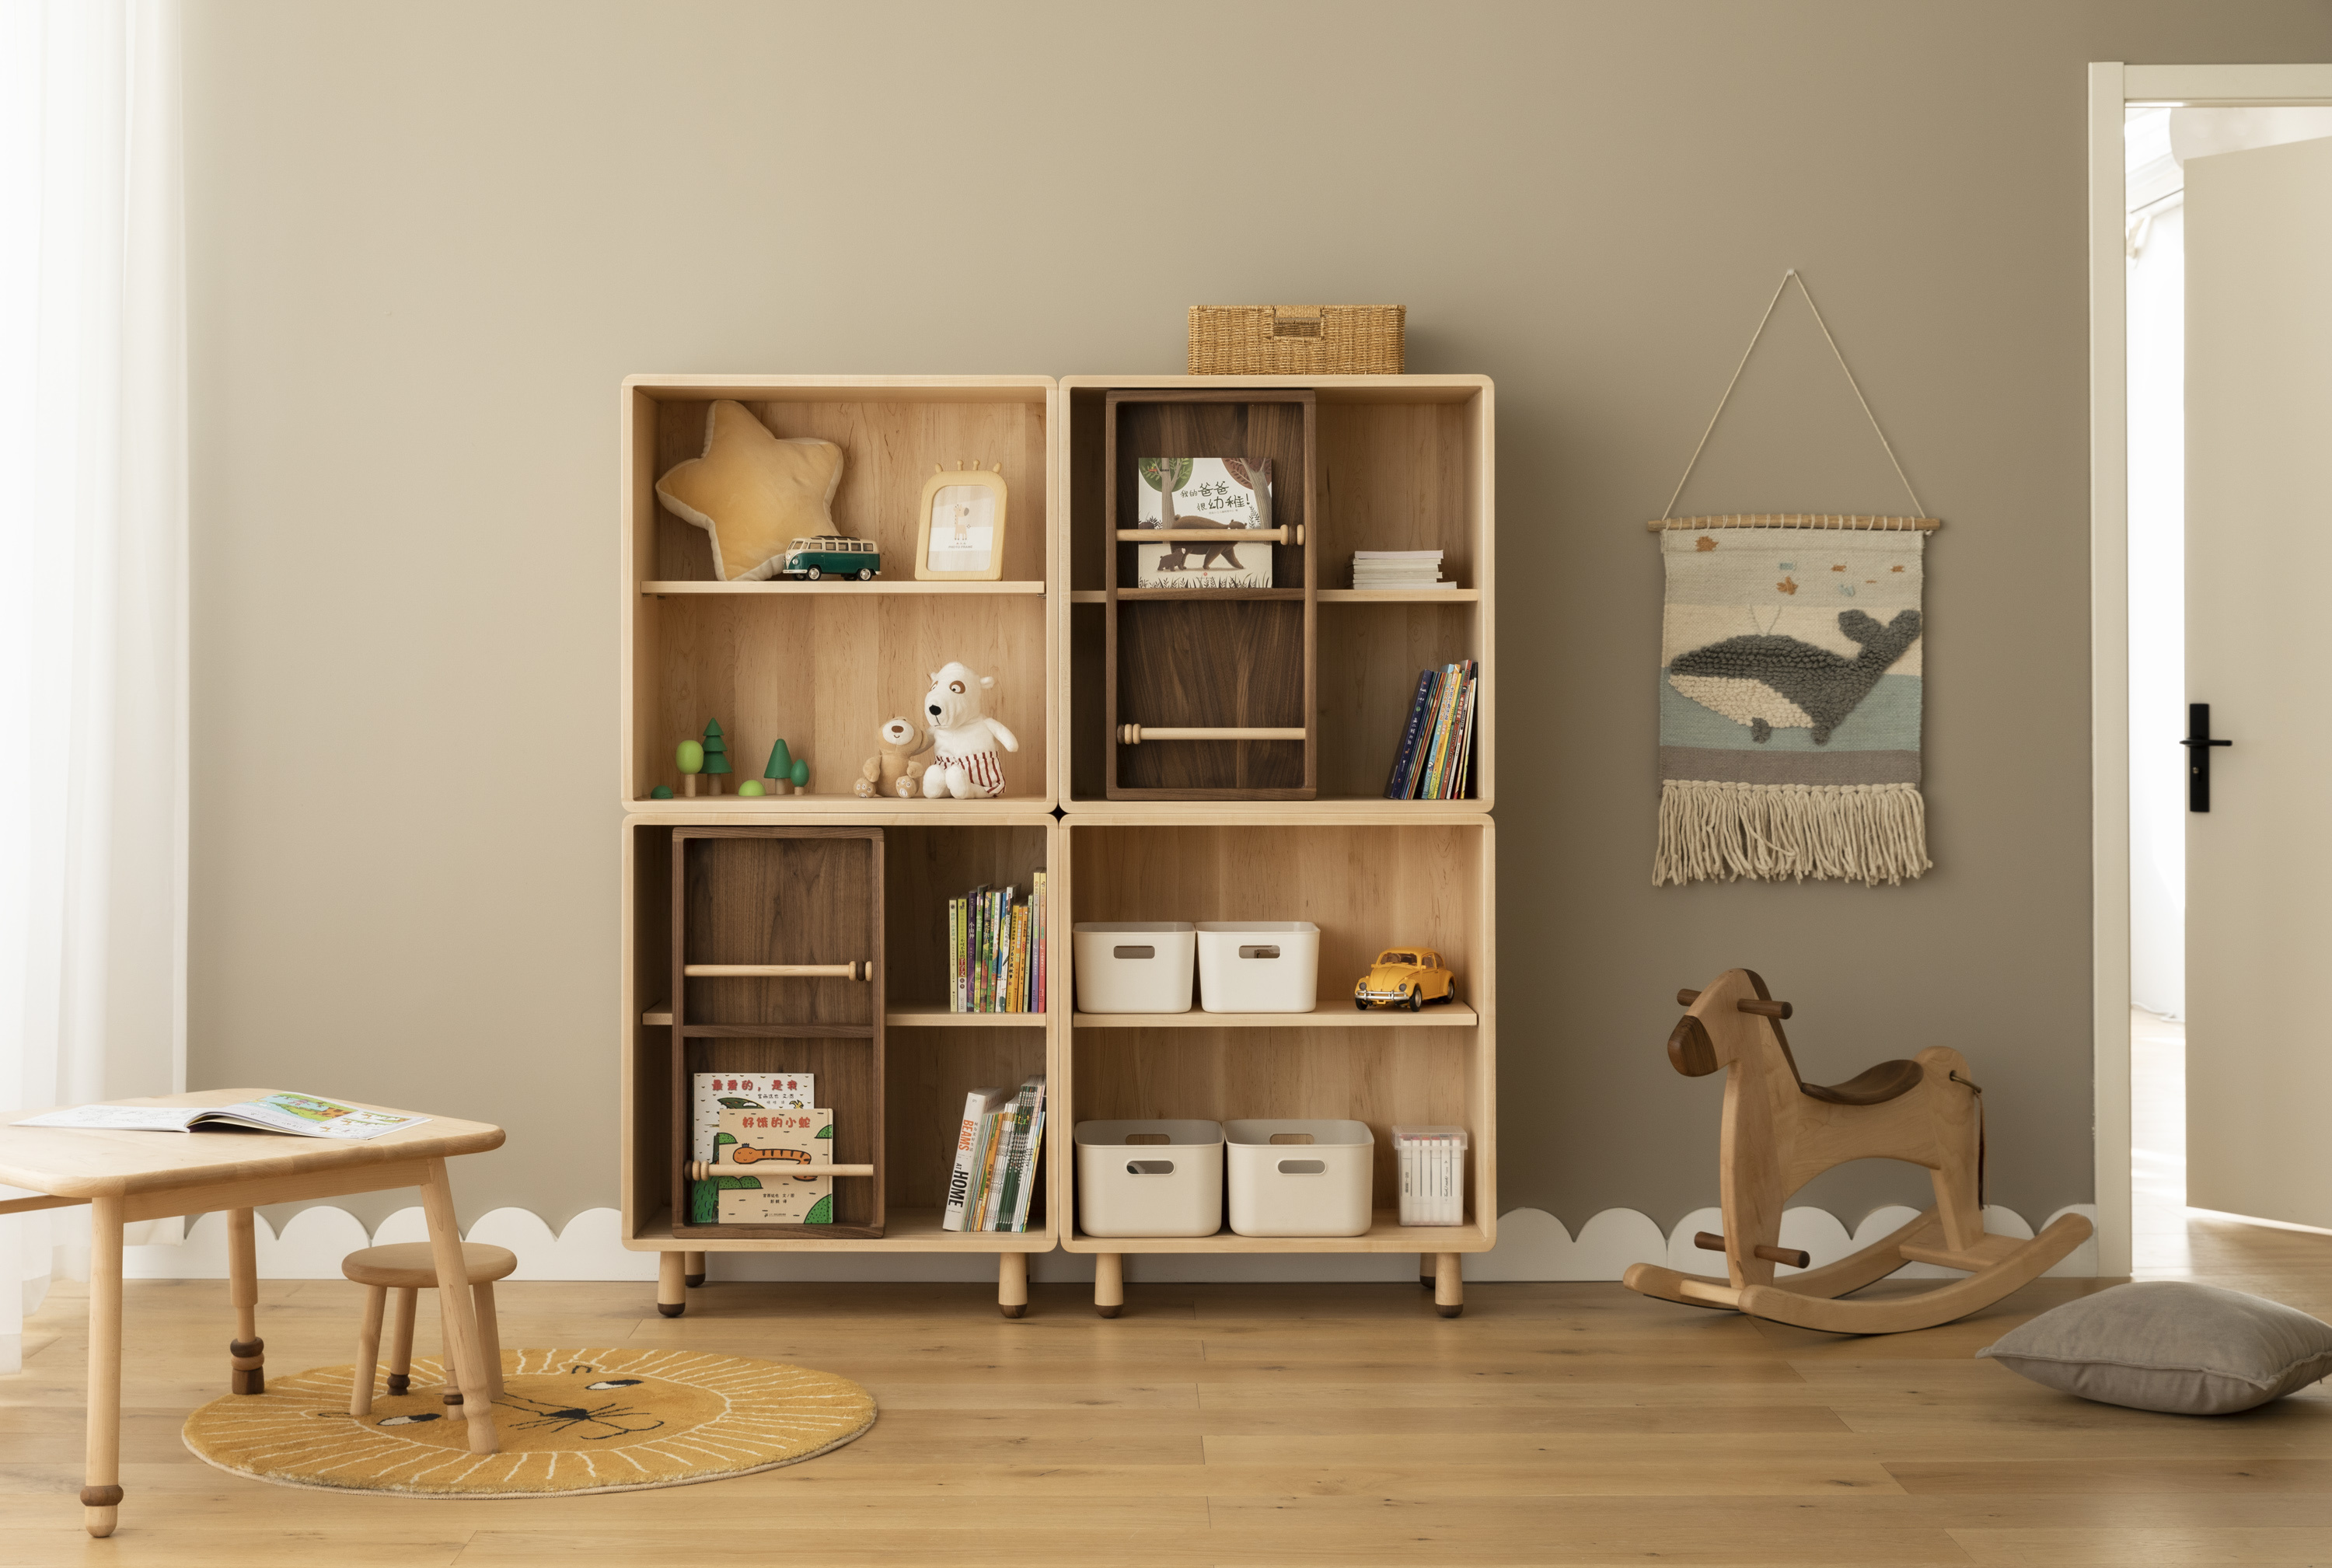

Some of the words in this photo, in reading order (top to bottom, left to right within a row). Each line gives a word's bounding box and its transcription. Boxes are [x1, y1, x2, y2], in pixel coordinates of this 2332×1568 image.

[1180, 480, 1229, 498] 我的爸爸
[742, 1116, 811, 1128] 好饿的小蛇
[958, 1119, 974, 1151] BEAMS
[948, 1171, 969, 1208] HOME
